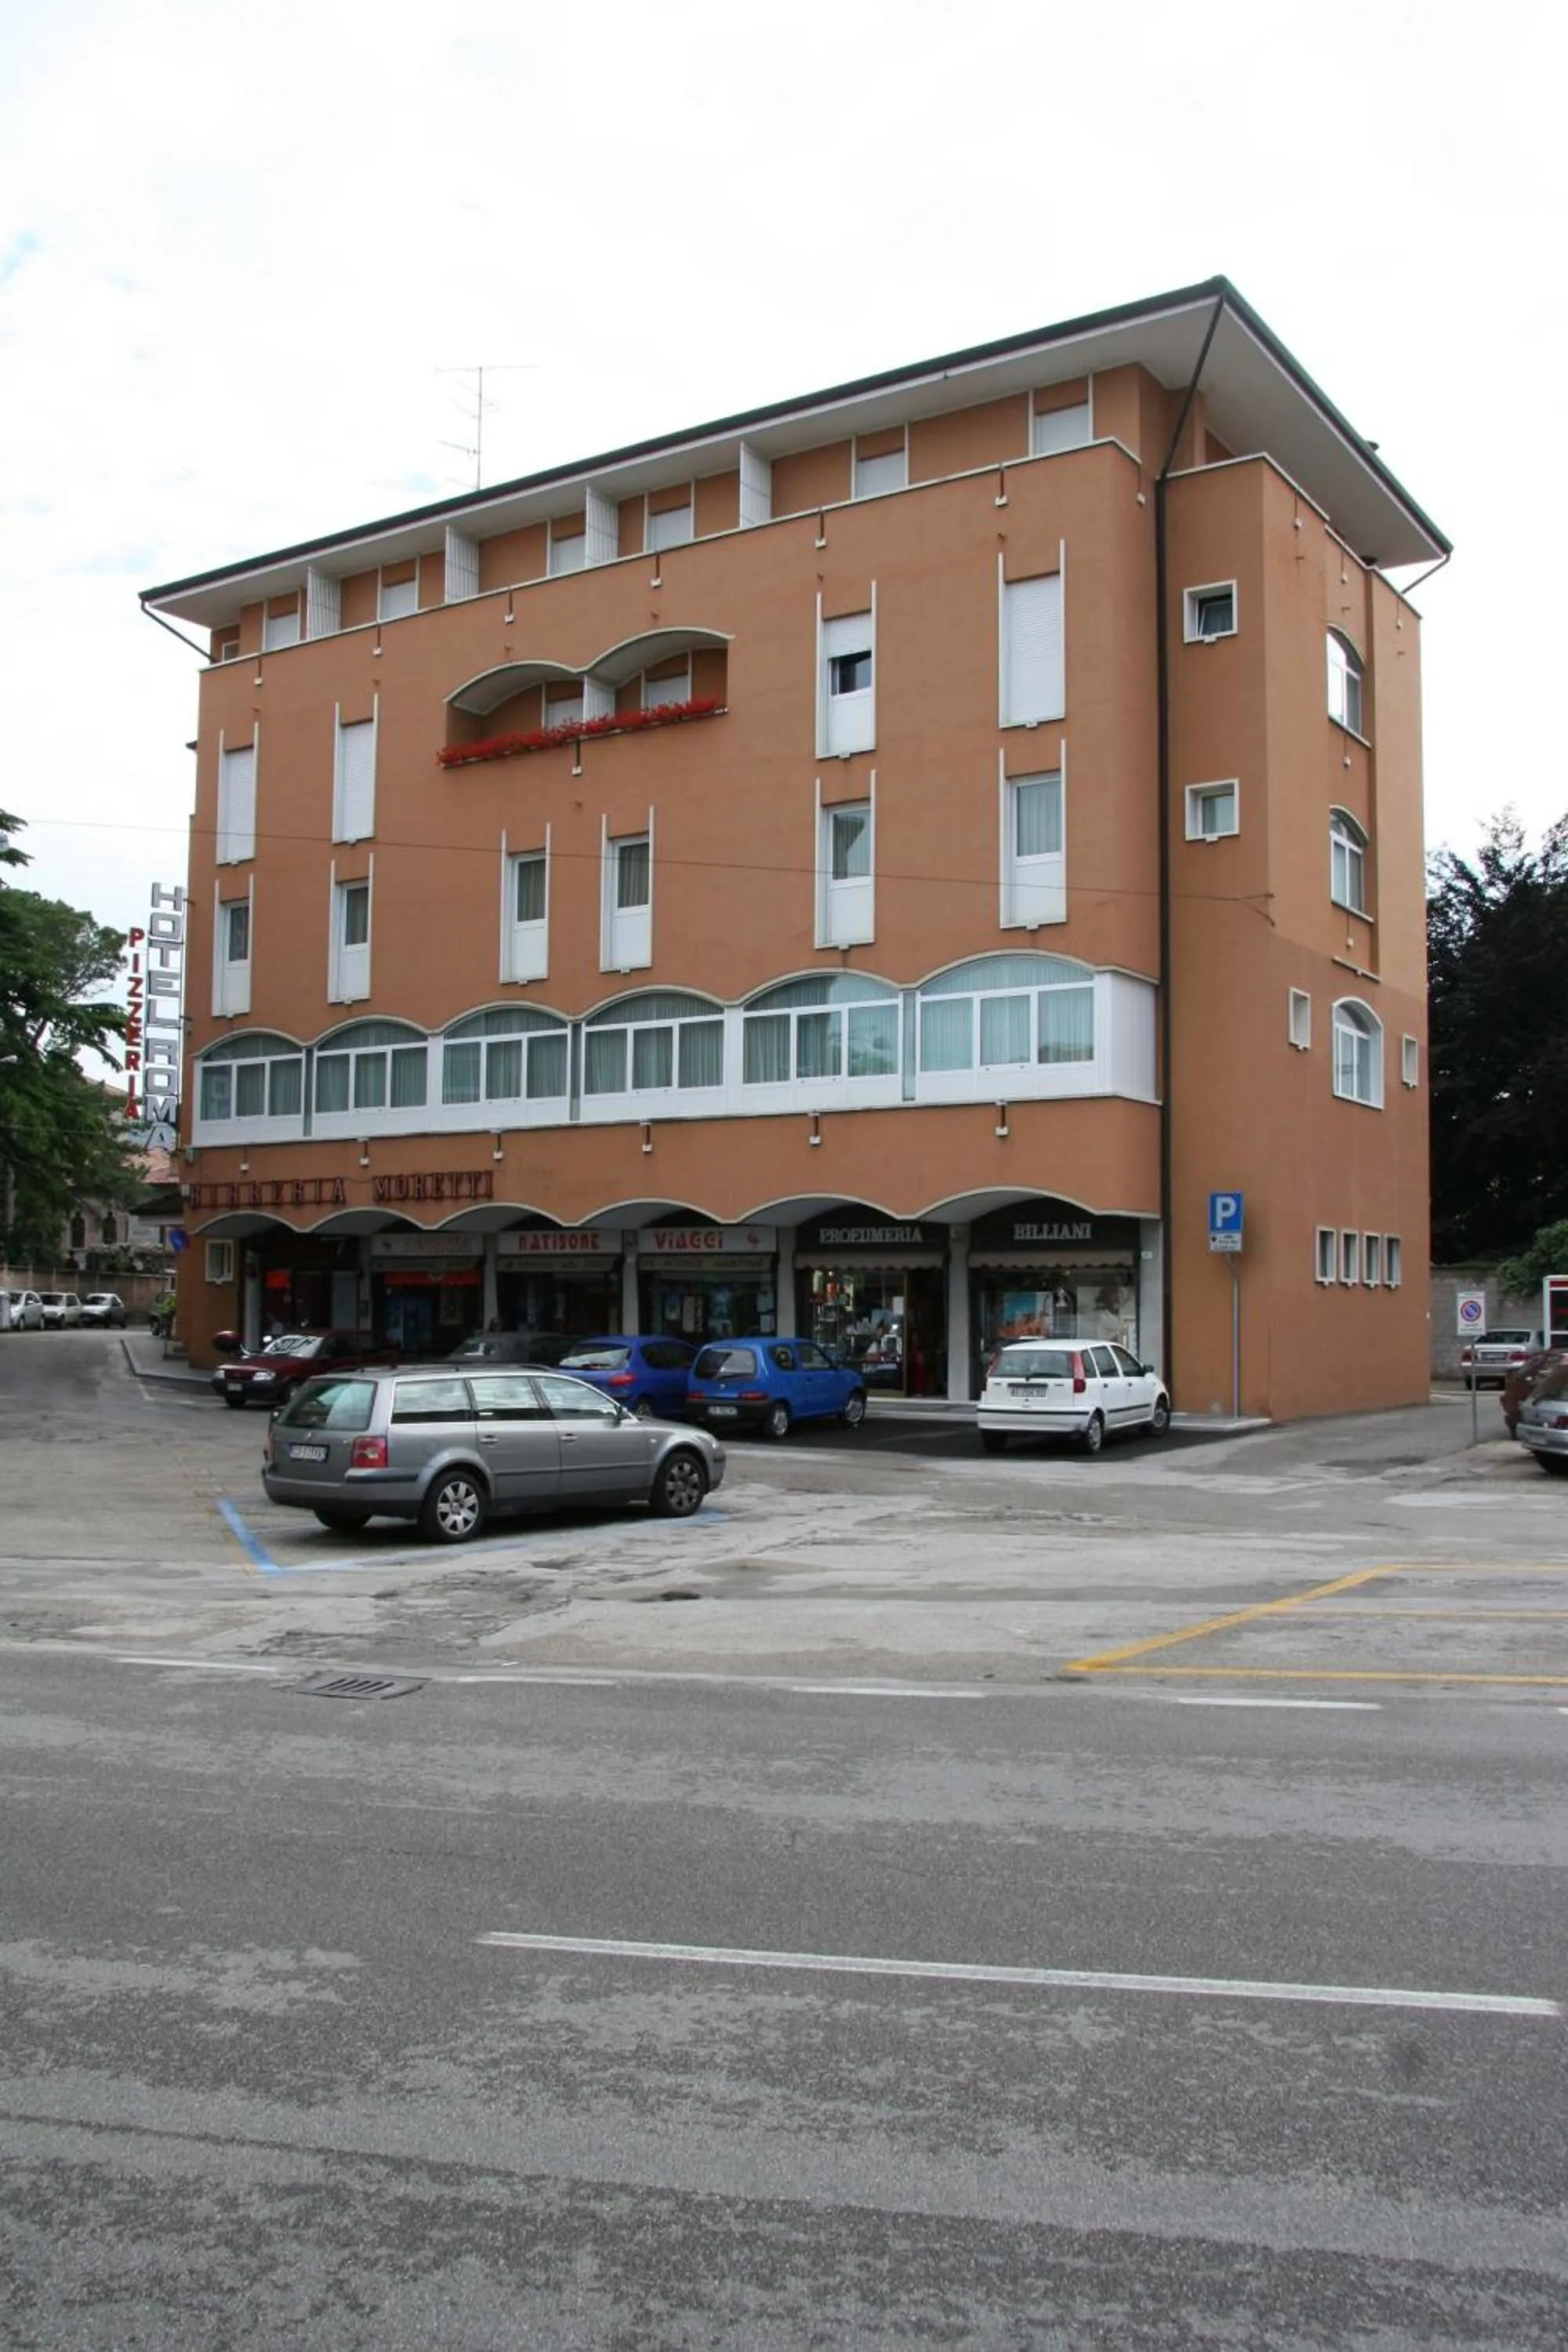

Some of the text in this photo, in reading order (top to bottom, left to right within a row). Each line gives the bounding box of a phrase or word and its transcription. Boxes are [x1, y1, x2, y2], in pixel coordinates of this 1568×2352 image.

[125, 927, 145, 1120] PIZZERIA
[144, 881, 183, 1152] HOTEL ROMA
[372, 1170, 494, 1202] MORETTI
[1216, 1196, 1236, 1228] P
[818, 1222, 1092, 1243] PROFUMERIA BILLIANI
